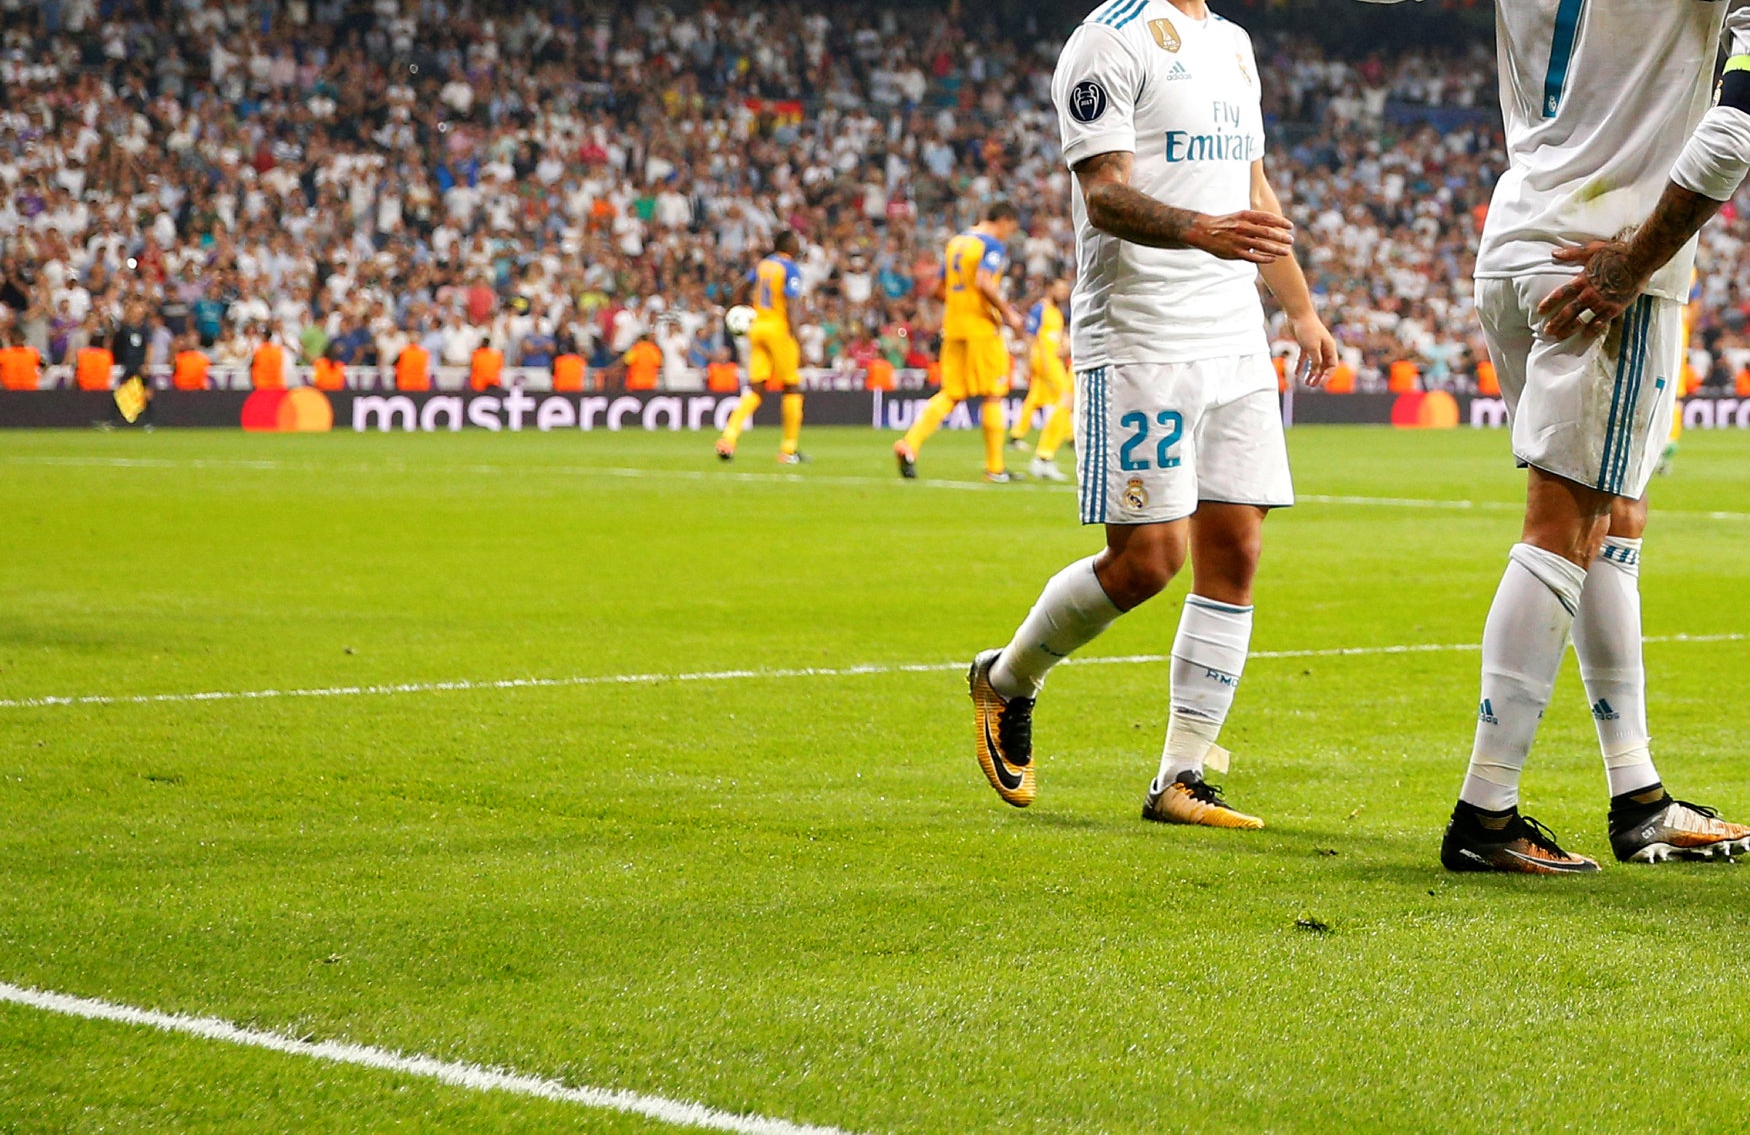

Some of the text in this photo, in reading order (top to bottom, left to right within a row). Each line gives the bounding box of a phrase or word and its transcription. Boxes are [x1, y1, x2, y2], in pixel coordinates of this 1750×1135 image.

[1213, 101, 1240, 128] Fly
[352, 384, 755, 433] mastercard
[888, 398, 973, 431] UA
[1120, 410, 1184, 471] 22
